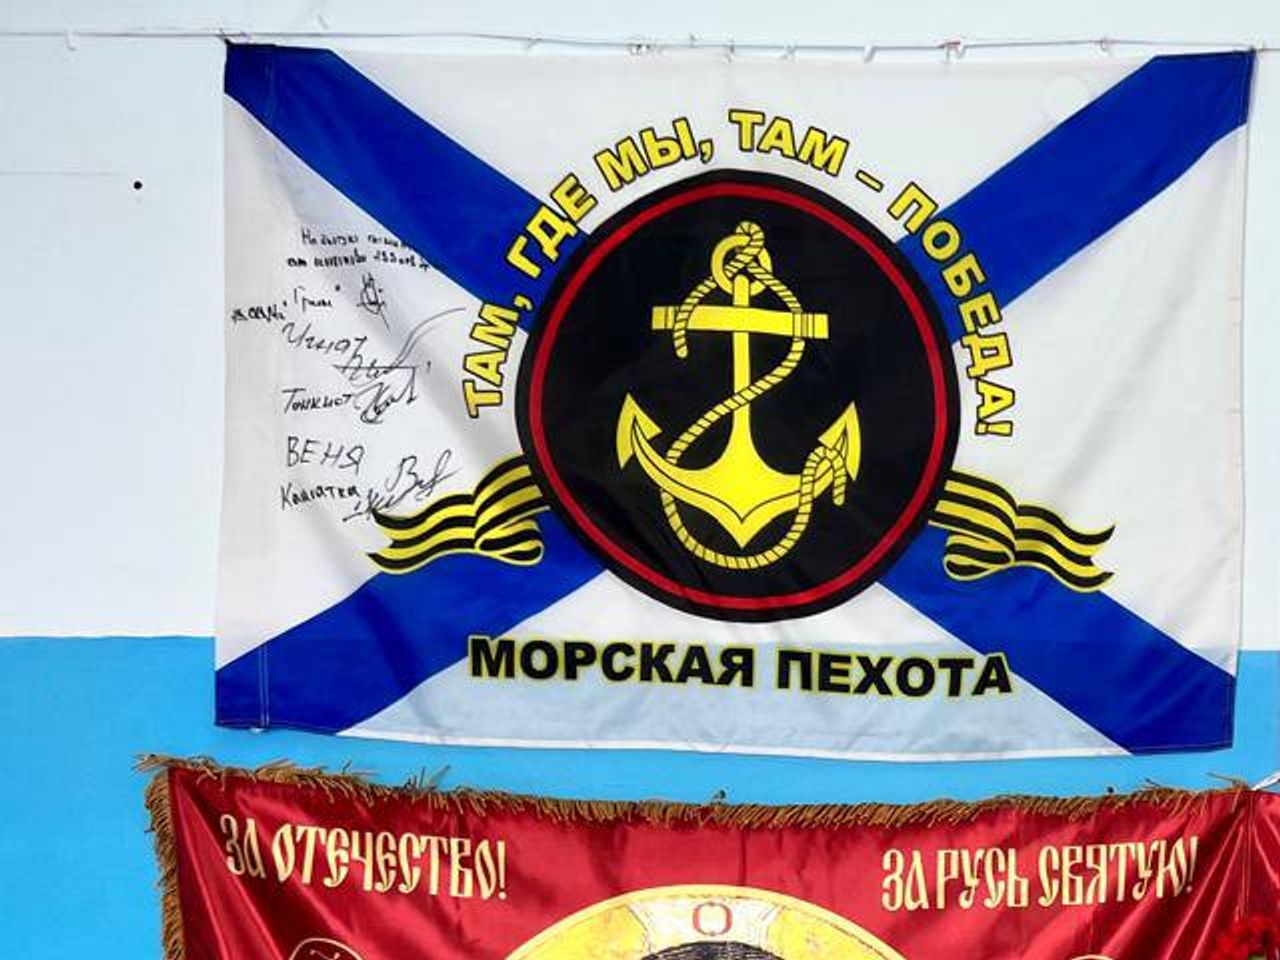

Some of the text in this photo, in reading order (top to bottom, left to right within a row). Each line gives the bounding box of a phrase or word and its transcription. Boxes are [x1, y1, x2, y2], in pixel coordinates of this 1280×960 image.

[463, 293, 533, 418] ТАМ,
[505, 172, 599, 279] ГДЕ
[593, 116, 714, 193] МЫ,
[728, 108, 850, 177] ТАМ
[886, 180, 1016, 437] ПОБЕДА!
[287, 435, 365, 476] ВЕНЯ
[469, 637, 1014, 698] МОРСКАЯ ПЕХОТА
[270, 822, 508, 900] ОТЕЧЕСТВО!
[881, 836, 1199, 912] ЗА РУСЬ СВЯТУЮ!
